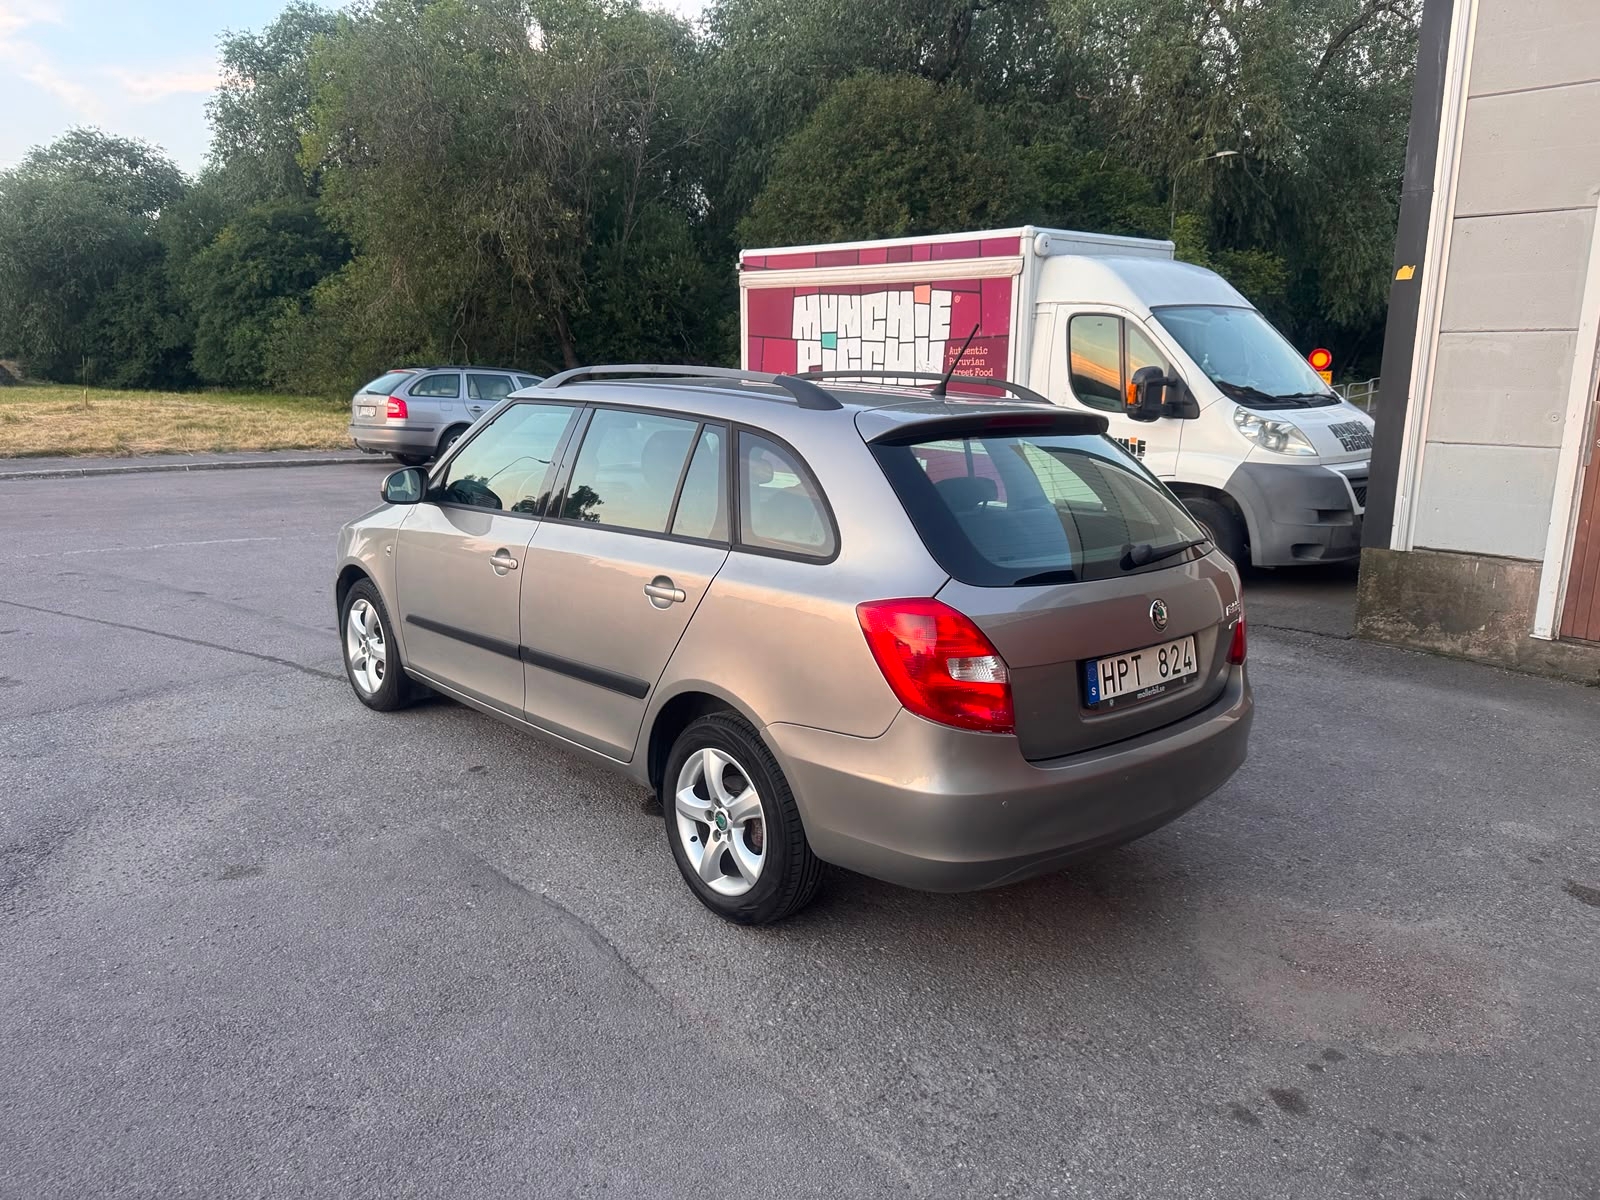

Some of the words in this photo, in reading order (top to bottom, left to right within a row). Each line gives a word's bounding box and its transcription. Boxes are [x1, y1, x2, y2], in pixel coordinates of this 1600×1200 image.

[950, 369, 973, 377] treet
[974, 367, 994, 377] Food
[1101, 654, 1141, 695] HPT
[1158, 640, 1192, 678] 824
[1091, 687, 1097, 696] S
